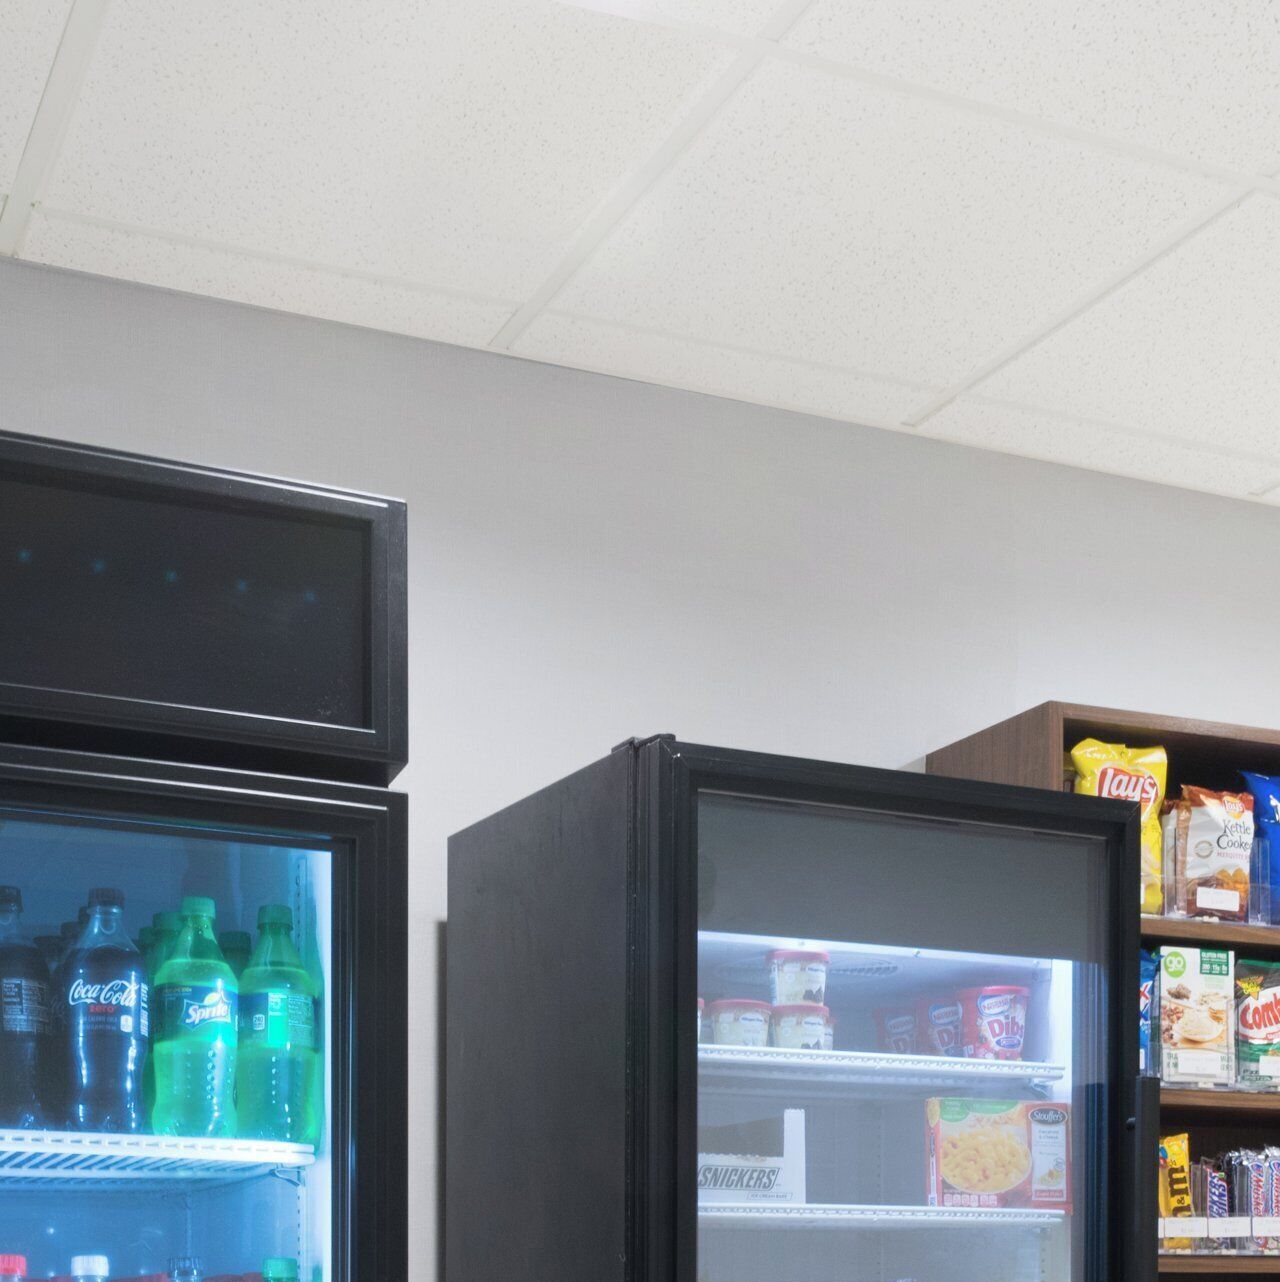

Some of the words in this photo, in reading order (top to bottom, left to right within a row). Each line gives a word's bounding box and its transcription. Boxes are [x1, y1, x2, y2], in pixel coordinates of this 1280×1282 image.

[1101, 768, 1157, 802] Lay's
[1223, 819, 1251, 836] Kettle
[1217, 834, 1250, 851] Cooke
[90, 1005, 114, 1013] zero
[186, 1004, 228, 1025] Sprite
[1033, 1110, 1064, 1123] Stouffer's
[699, 1167, 777, 1190] SNICKERS
